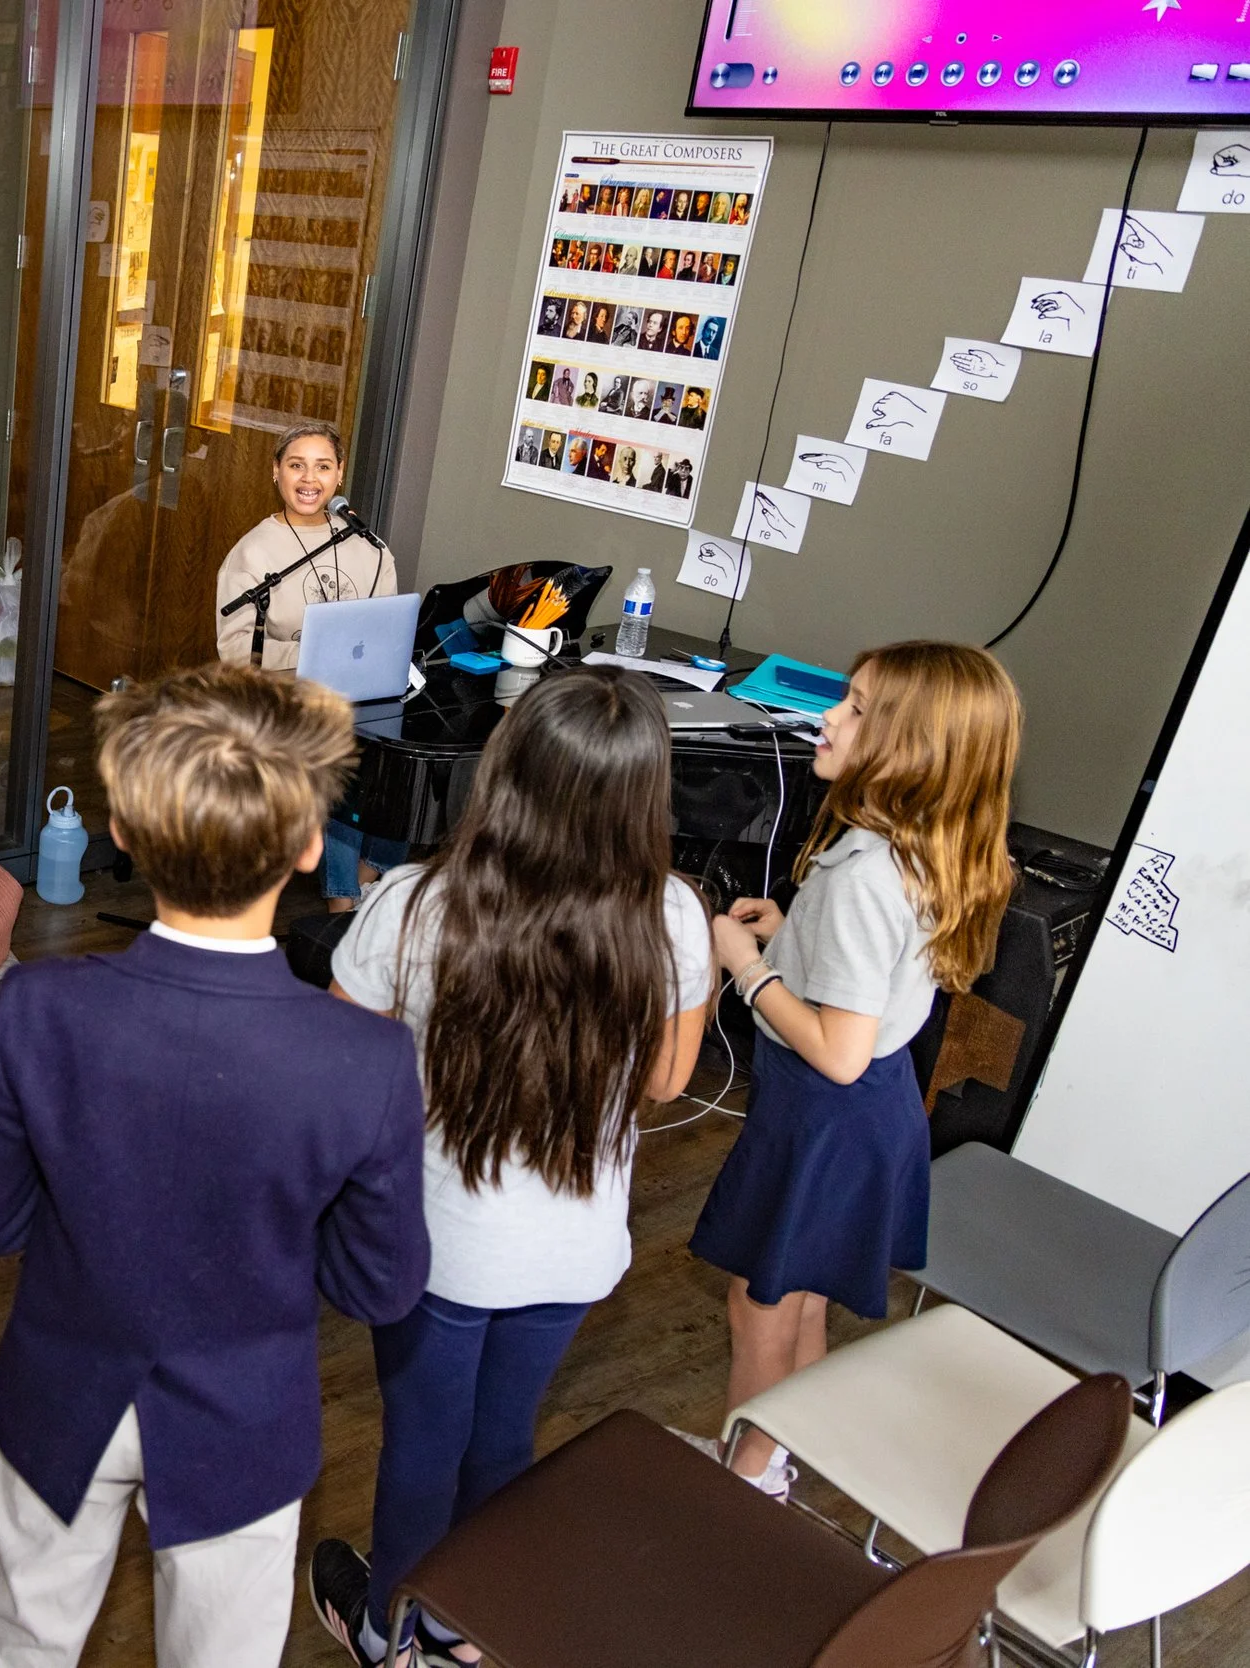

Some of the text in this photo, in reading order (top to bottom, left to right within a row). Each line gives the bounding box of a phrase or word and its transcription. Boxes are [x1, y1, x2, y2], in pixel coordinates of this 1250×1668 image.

[491, 68, 508, 77] FIRE
[592, 141, 743, 161] THE GREAT COMPOSERS
[1222, 190, 1245, 205] do
[1126, 266, 1136, 280] ti
[1038, 330, 1053, 344] la
[962, 380, 978, 391] so
[879, 431, 892, 446] fa
[812, 481, 827, 493] mi
[759, 529, 771, 540] re
[703, 574, 718, 587] do
